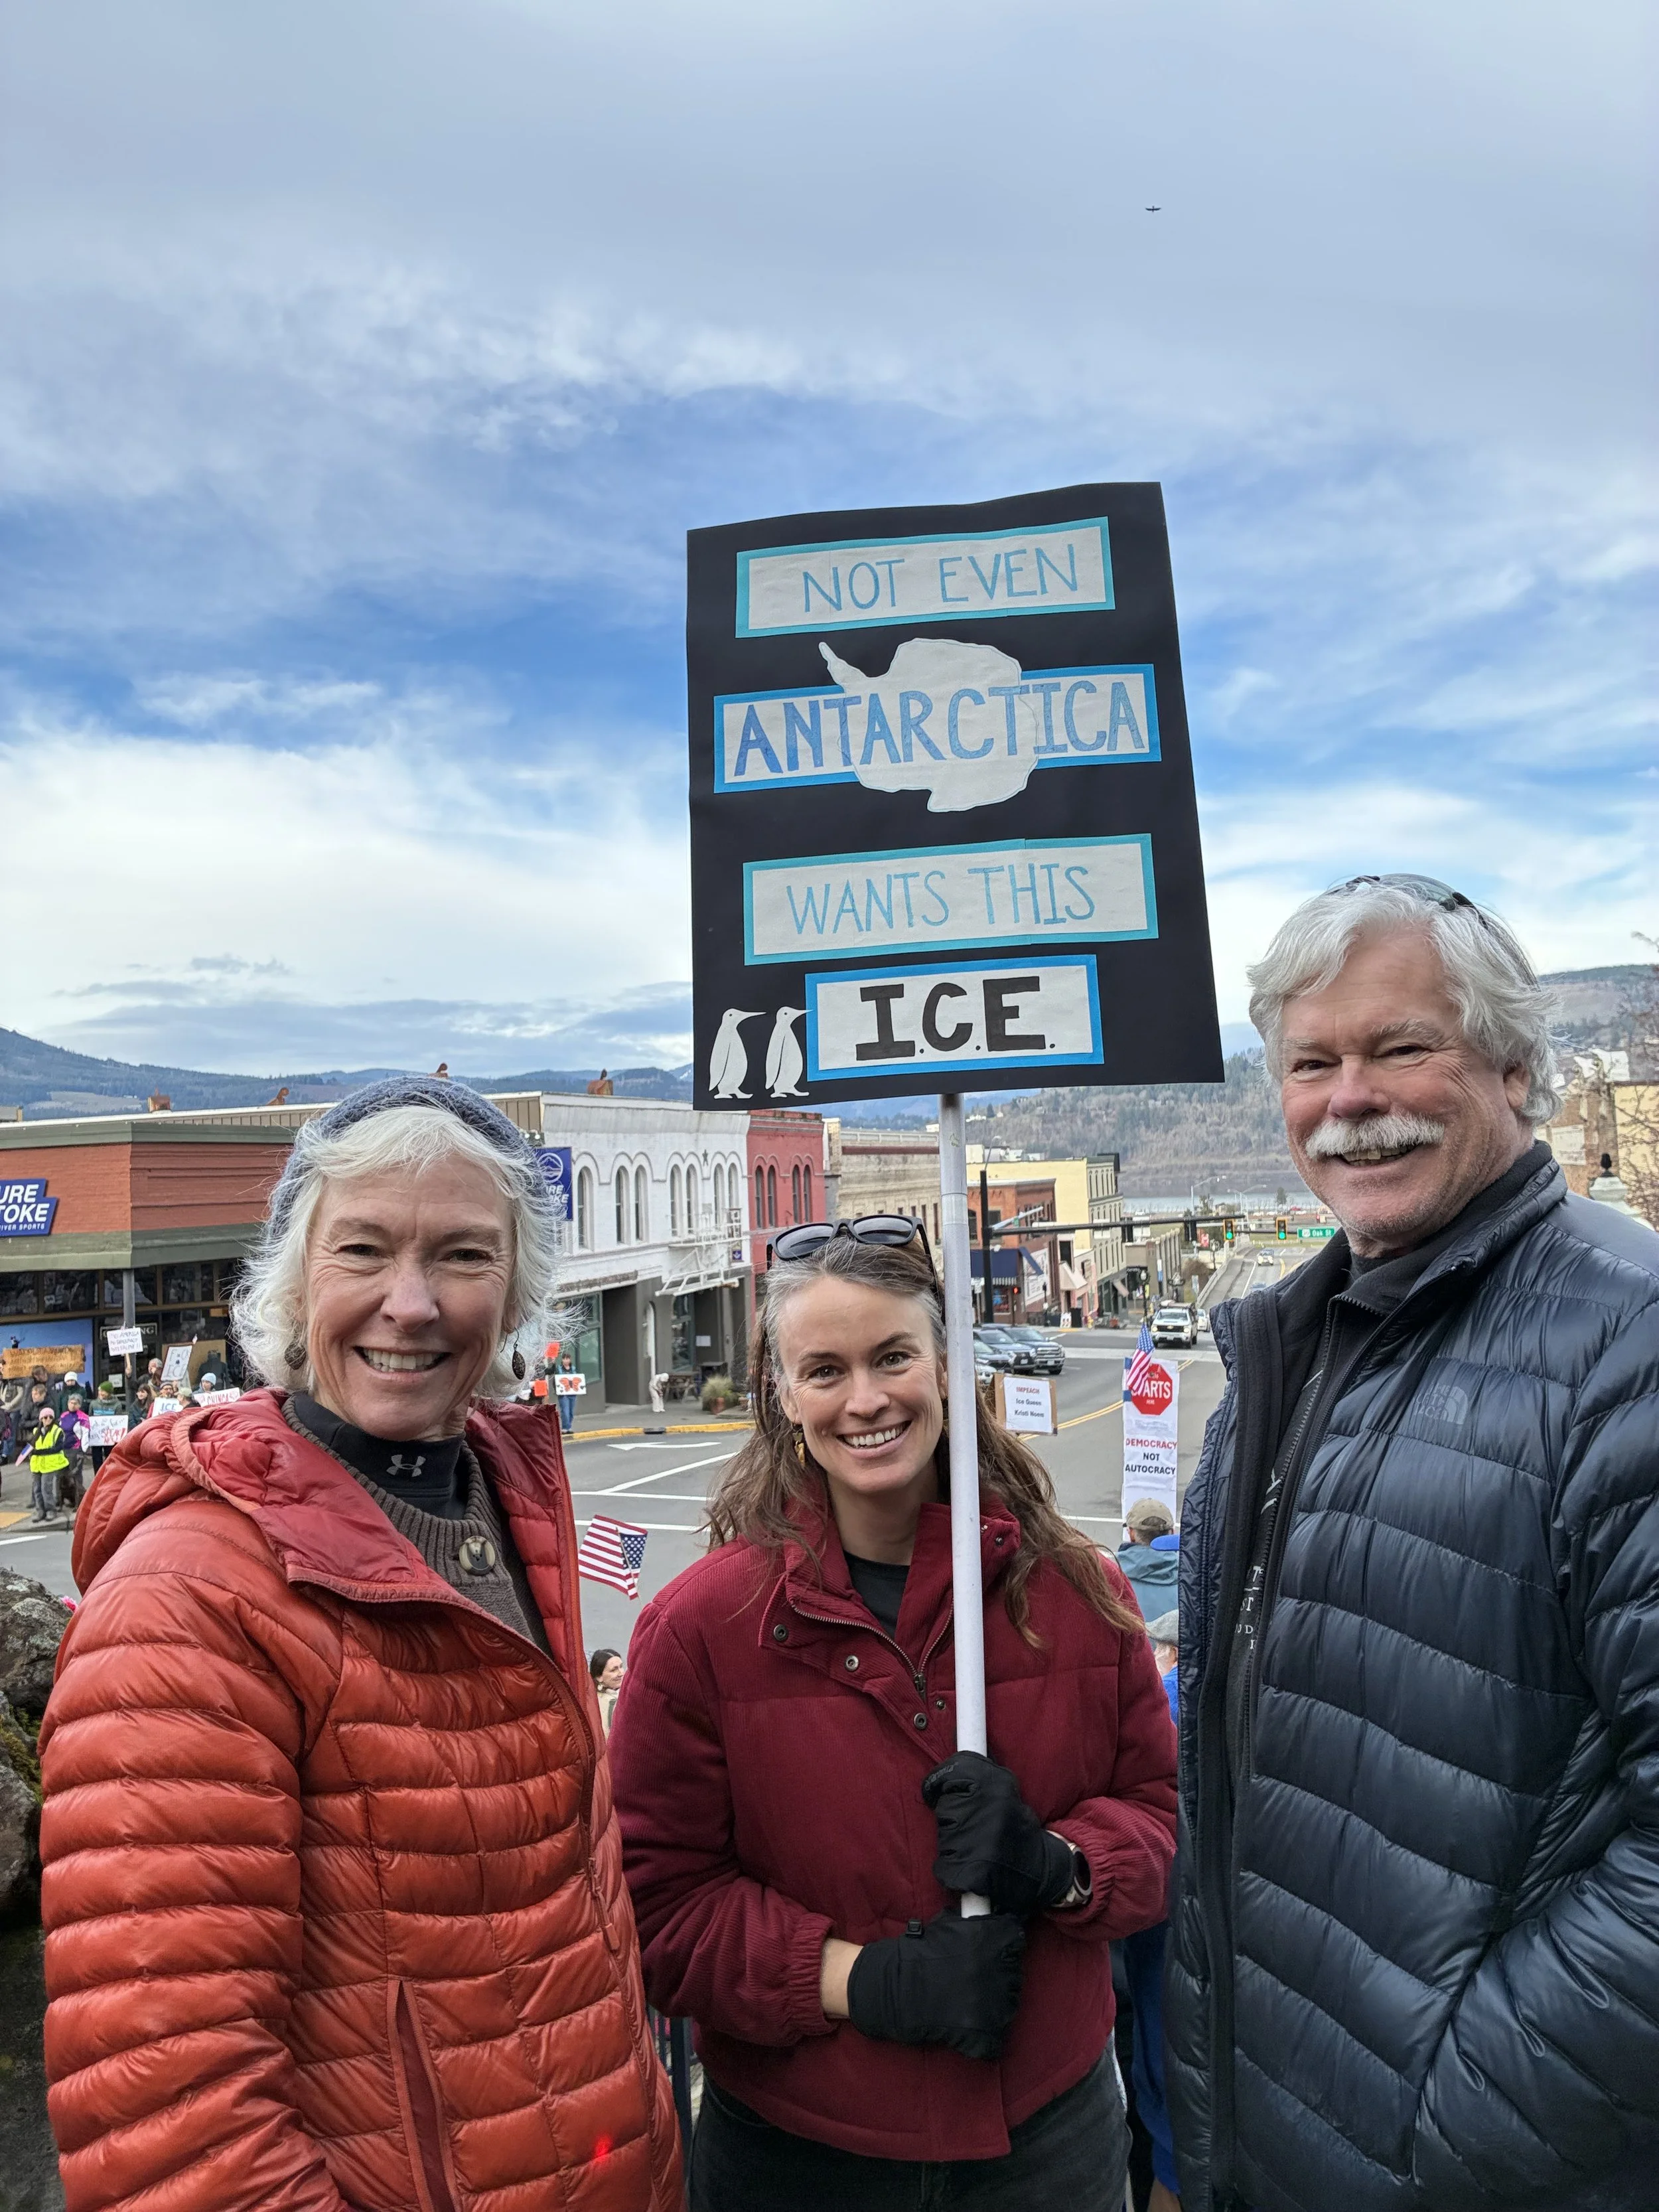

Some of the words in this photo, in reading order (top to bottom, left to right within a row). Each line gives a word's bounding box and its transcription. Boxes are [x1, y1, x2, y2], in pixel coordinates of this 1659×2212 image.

[804, 558, 904, 614] NOT
[939, 543, 1079, 603] EVEN
[733, 680, 1147, 777] ANTARCTICA
[786, 869, 950, 936] WANTS
[967, 863, 1098, 925] THIS
[855, 975, 1056, 1062] I.C.E.
[1125, 1438, 1178, 1449] DEMOCRACY
[1125, 1463, 1176, 1475] AUTOCRACY
[1143, 1452, 1160, 1461] NOT
